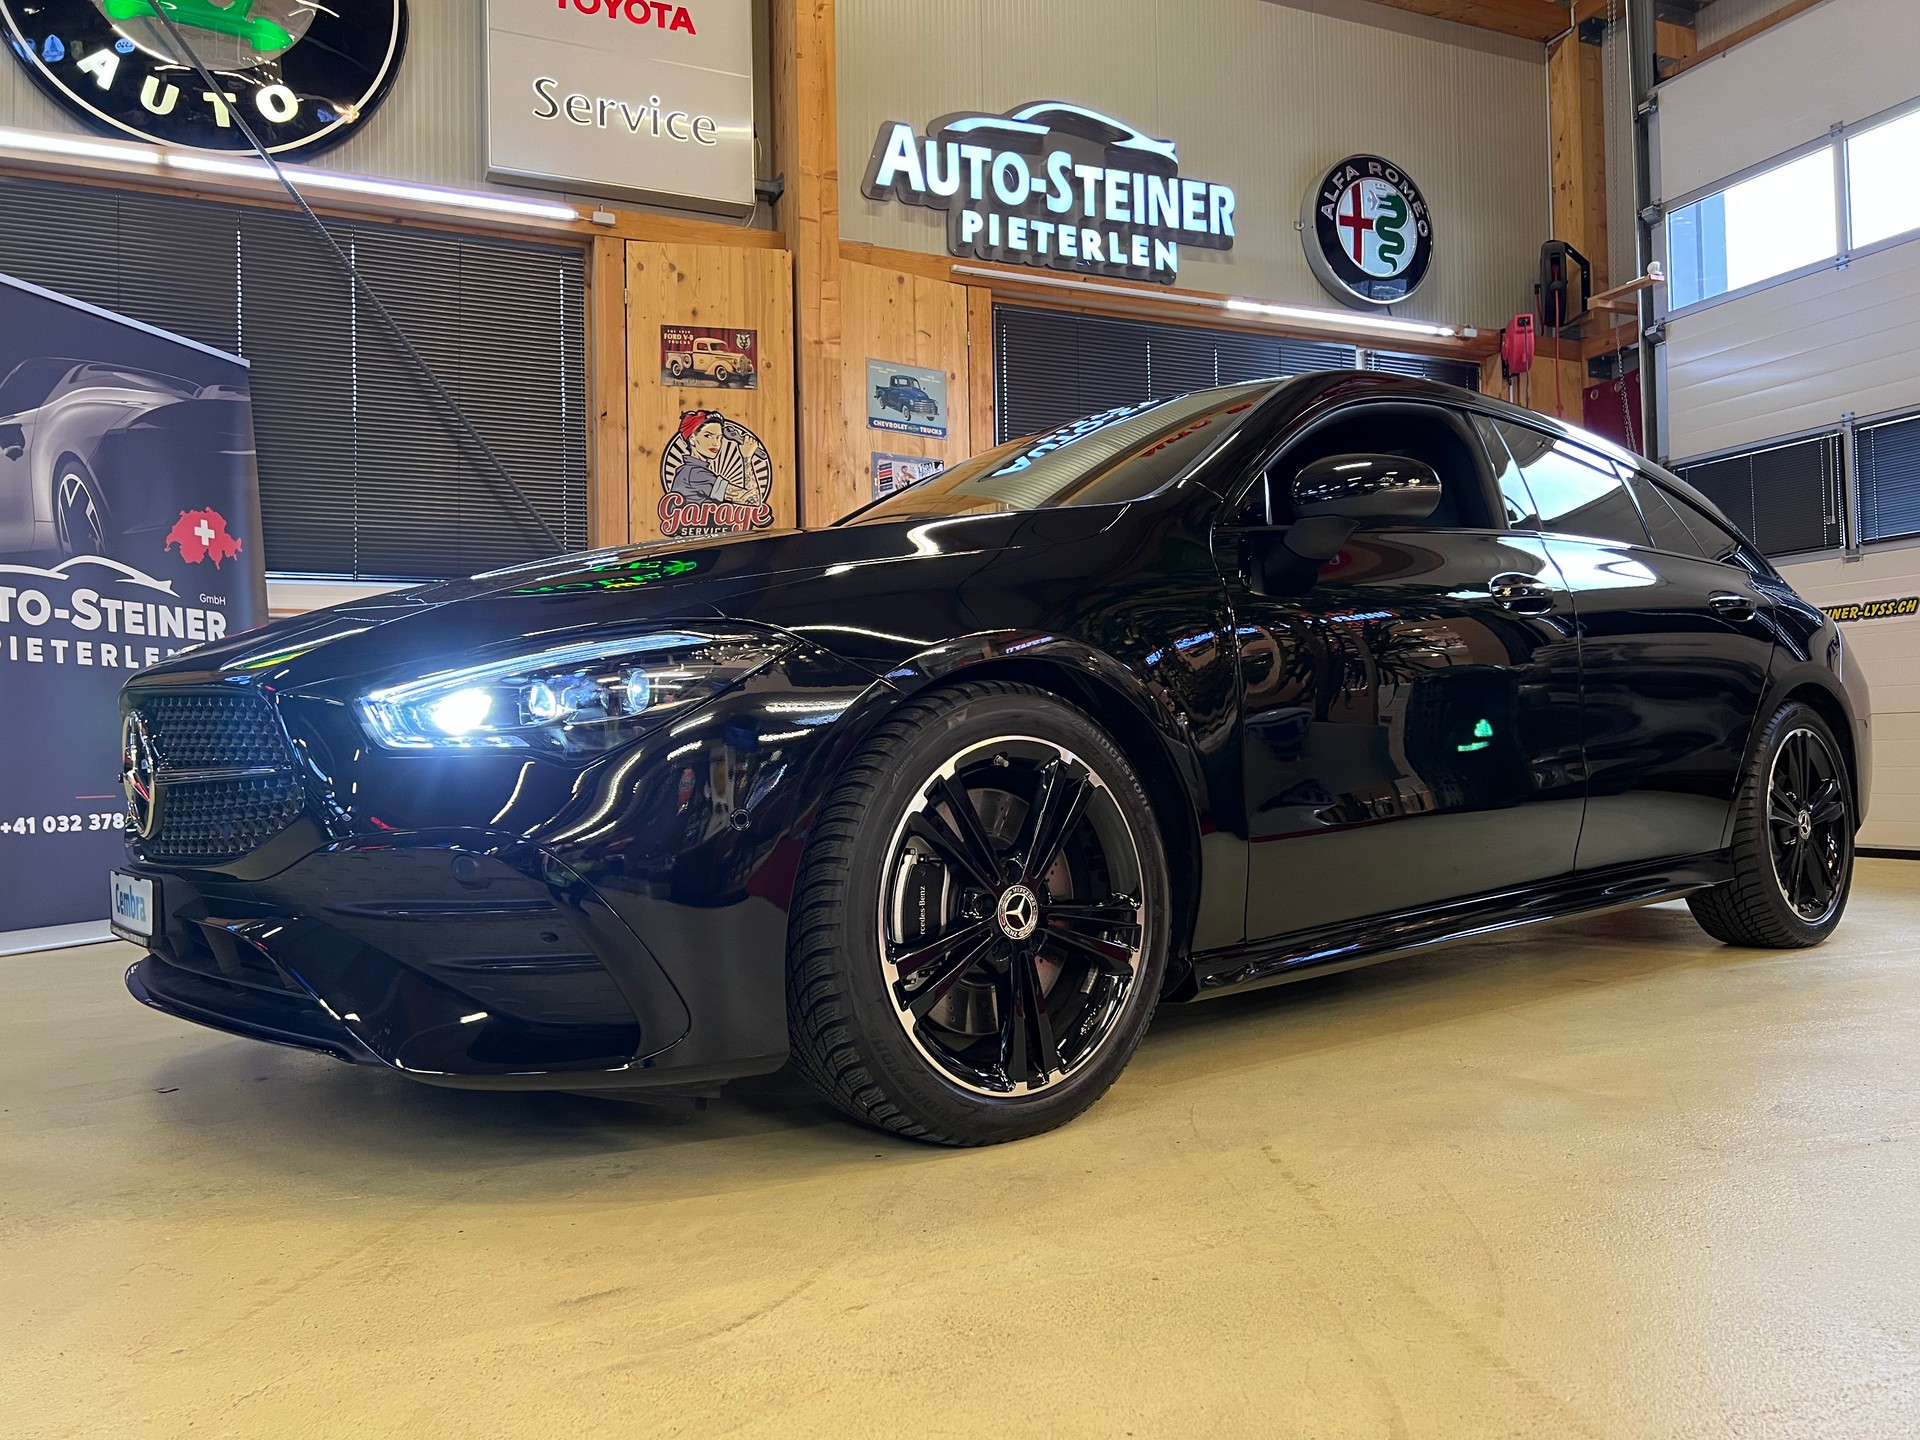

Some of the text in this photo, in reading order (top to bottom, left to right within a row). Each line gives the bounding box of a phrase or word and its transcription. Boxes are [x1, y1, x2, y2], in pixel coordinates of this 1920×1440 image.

[77, 48, 299, 127] AUTO
[533, 77, 717, 145] Service
[875, 124, 1236, 237] AUTO-STEINER
[1321, 161, 1429, 238] ALFA ROMEO
[962, 210, 1178, 273] PIETERLEN
[664, 332, 682, 340] FORD
[873, 419, 942, 435] CHEVROLET TRUCKS
[659, 492, 772, 535] Garage
[199, 593, 226, 606] GmbH
[0, 635, 183, 669] IETERLE
[1, 812, 125, 835] +41 032 378
[115, 882, 147, 923] Cembra
